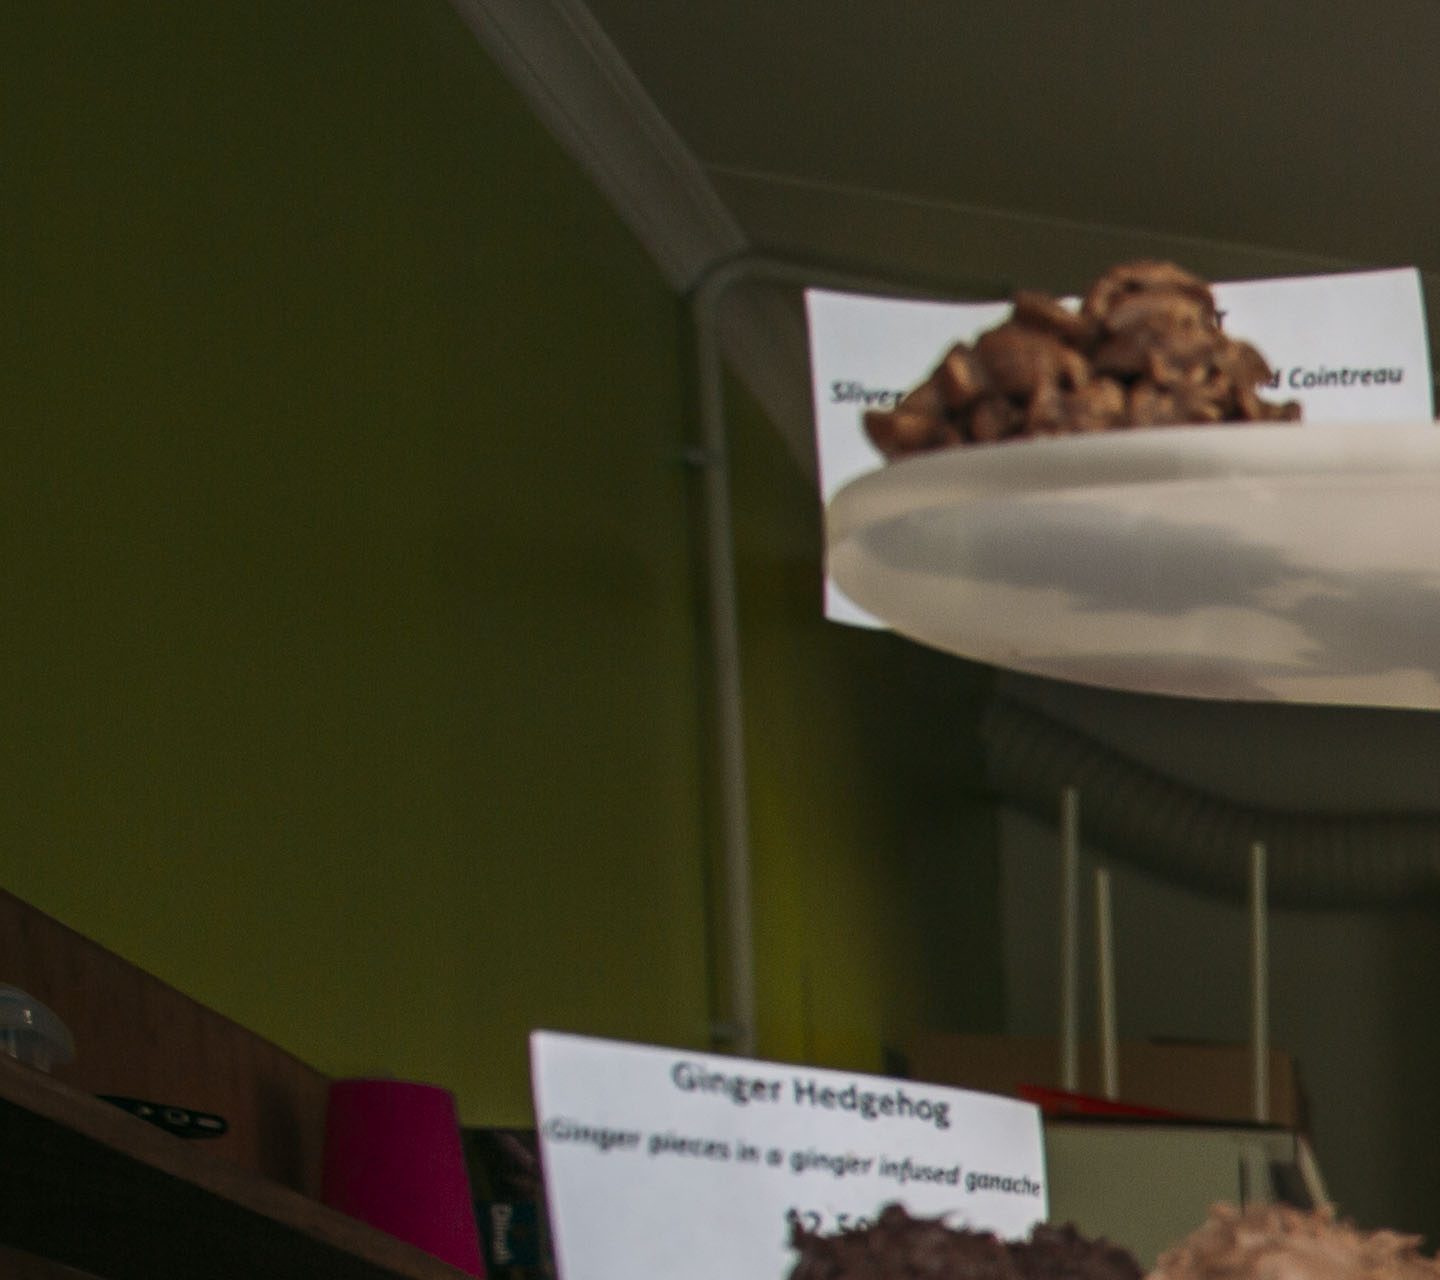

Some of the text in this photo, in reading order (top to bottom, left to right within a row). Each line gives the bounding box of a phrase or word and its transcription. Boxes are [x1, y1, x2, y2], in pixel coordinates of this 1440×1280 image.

[1289, 366, 1404, 389] Cointreau
[671, 1060, 952, 1128] Ginger Hedgehog
[550, 1117, 1041, 1198] Ginger pieces in a ginger infused ganache
